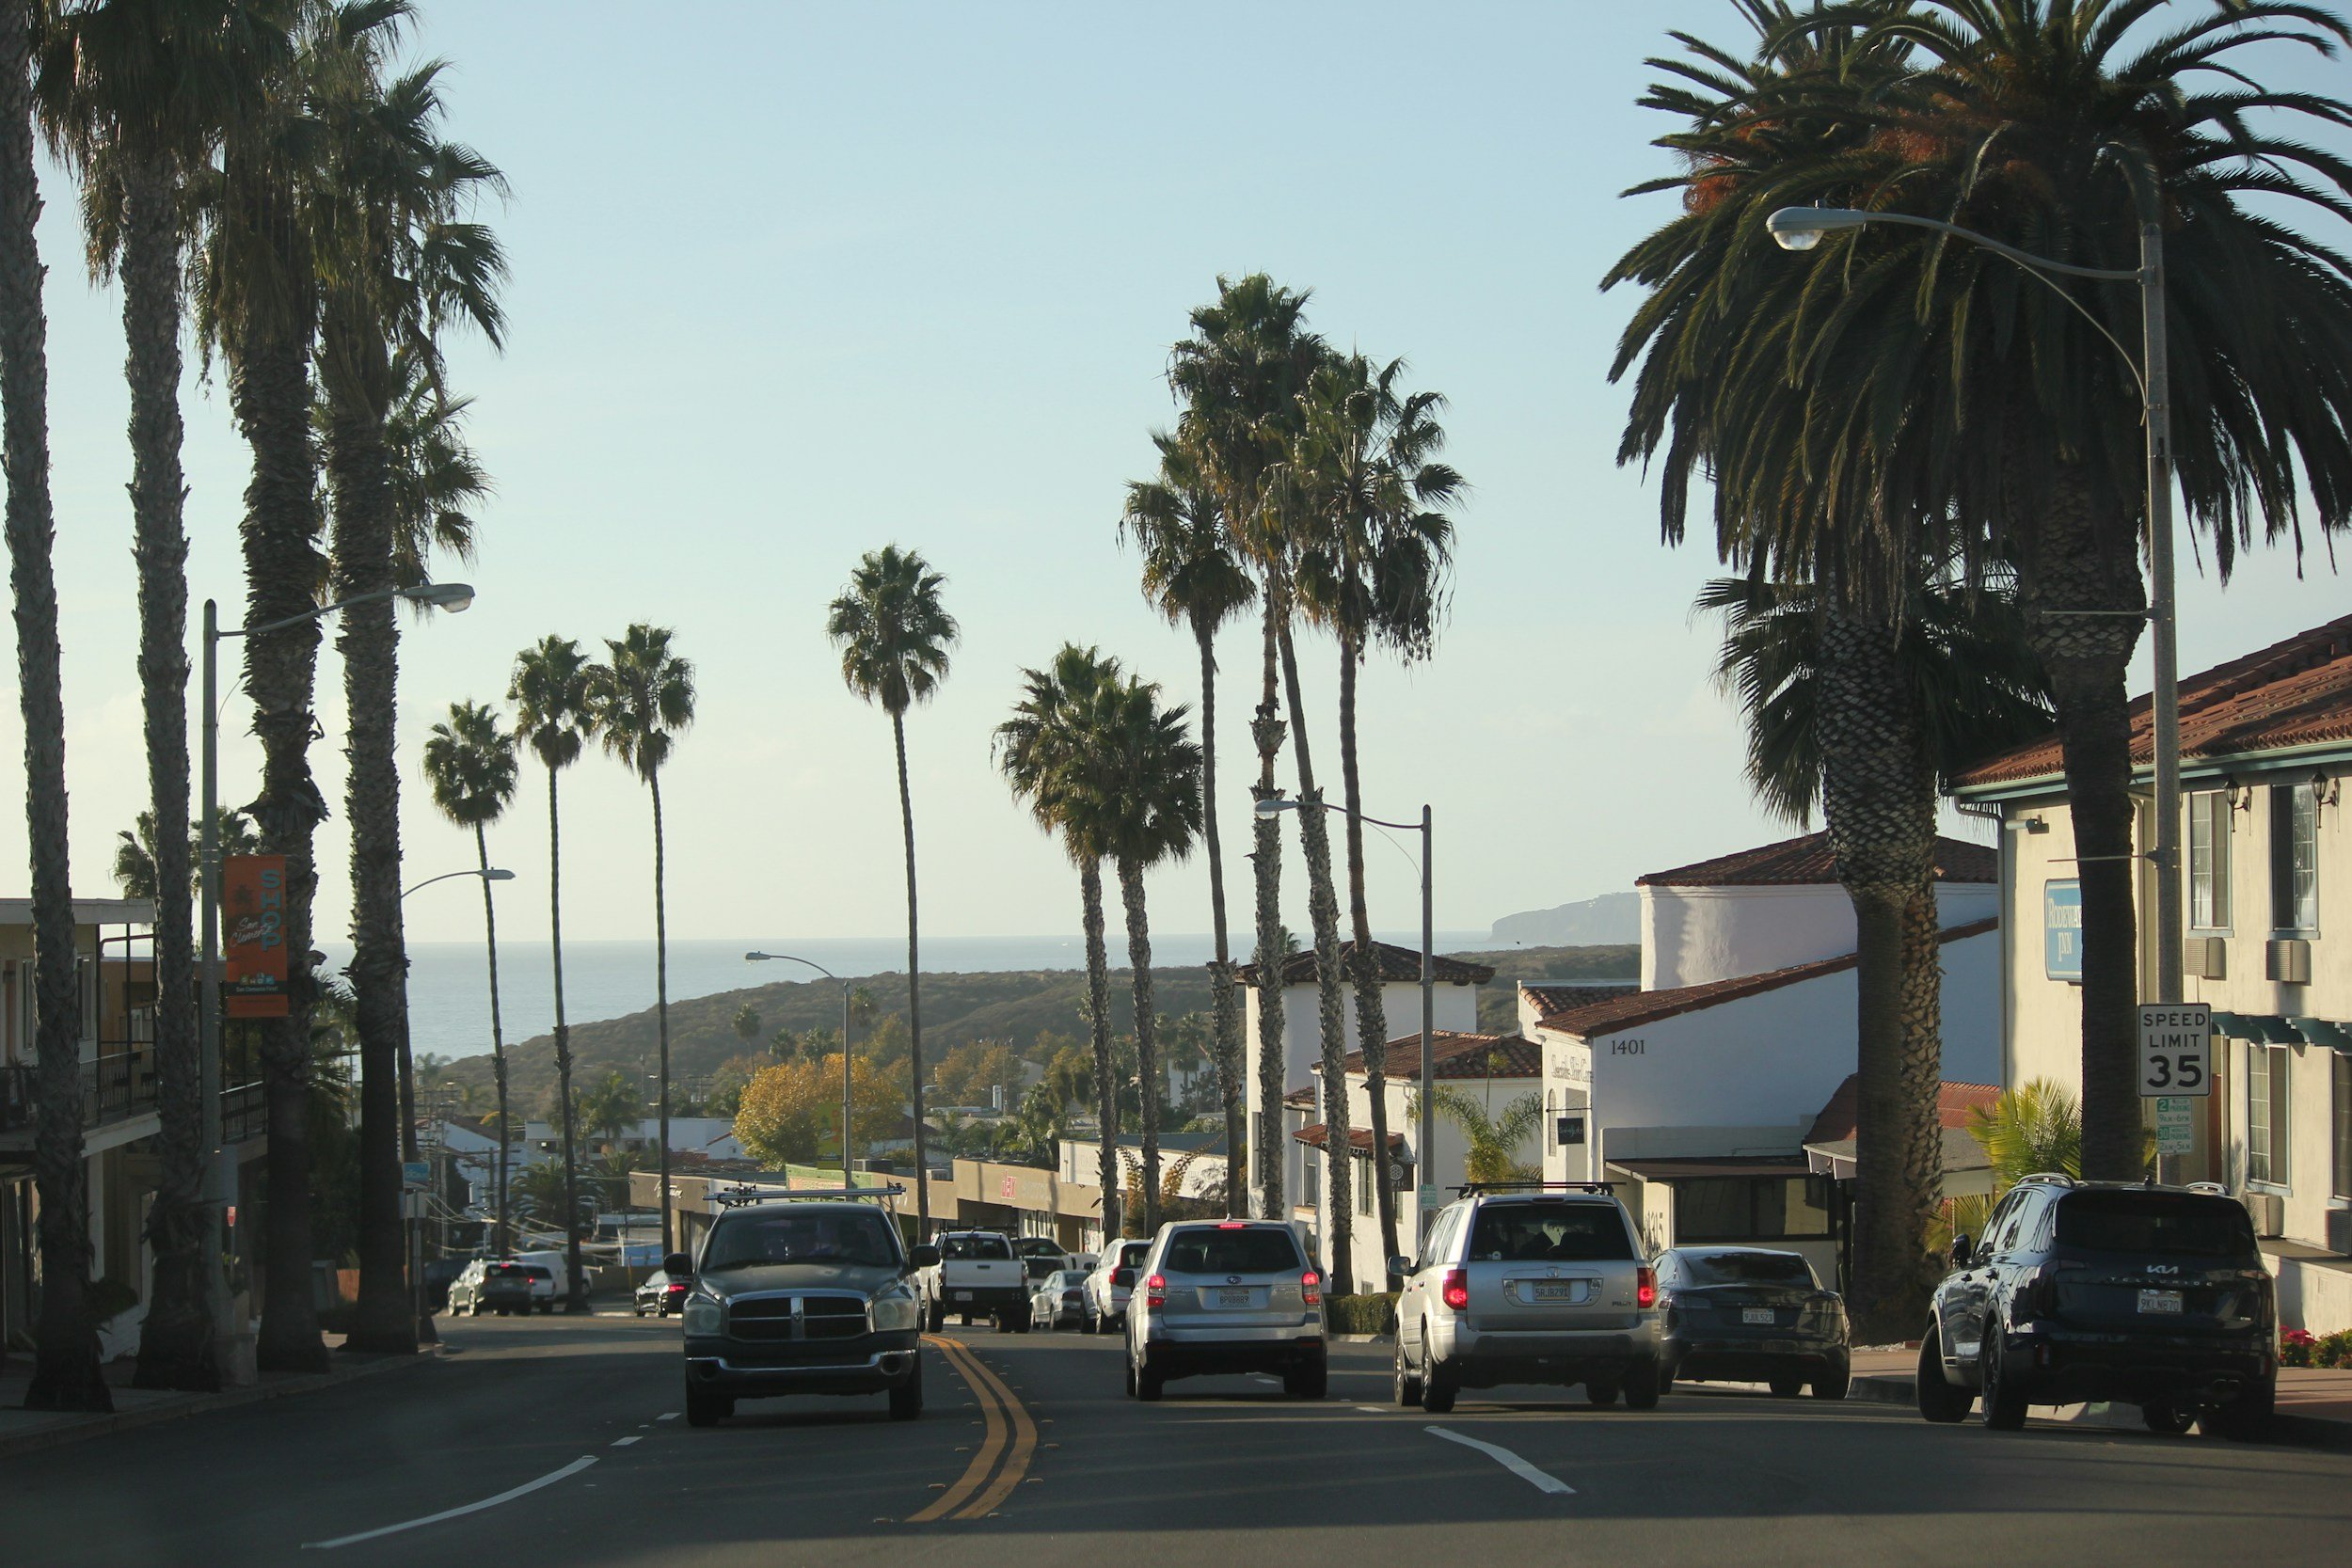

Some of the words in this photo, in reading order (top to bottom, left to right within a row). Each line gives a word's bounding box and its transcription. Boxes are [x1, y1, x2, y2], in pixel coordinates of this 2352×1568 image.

[261, 869, 281, 952] SHOP
[237, 917, 259, 932] San
[230, 924, 273, 948] Clemente
[2058, 932, 2072, 962] INN
[2143, 1013, 2206, 1027] SPEED
[1611, 1039, 1645, 1054] 1401
[2149, 1034, 2200, 1048] LIMIT
[2147, 1055, 2202, 1087] 35
[2111, 1277, 2213, 1287] TELLURIDE
